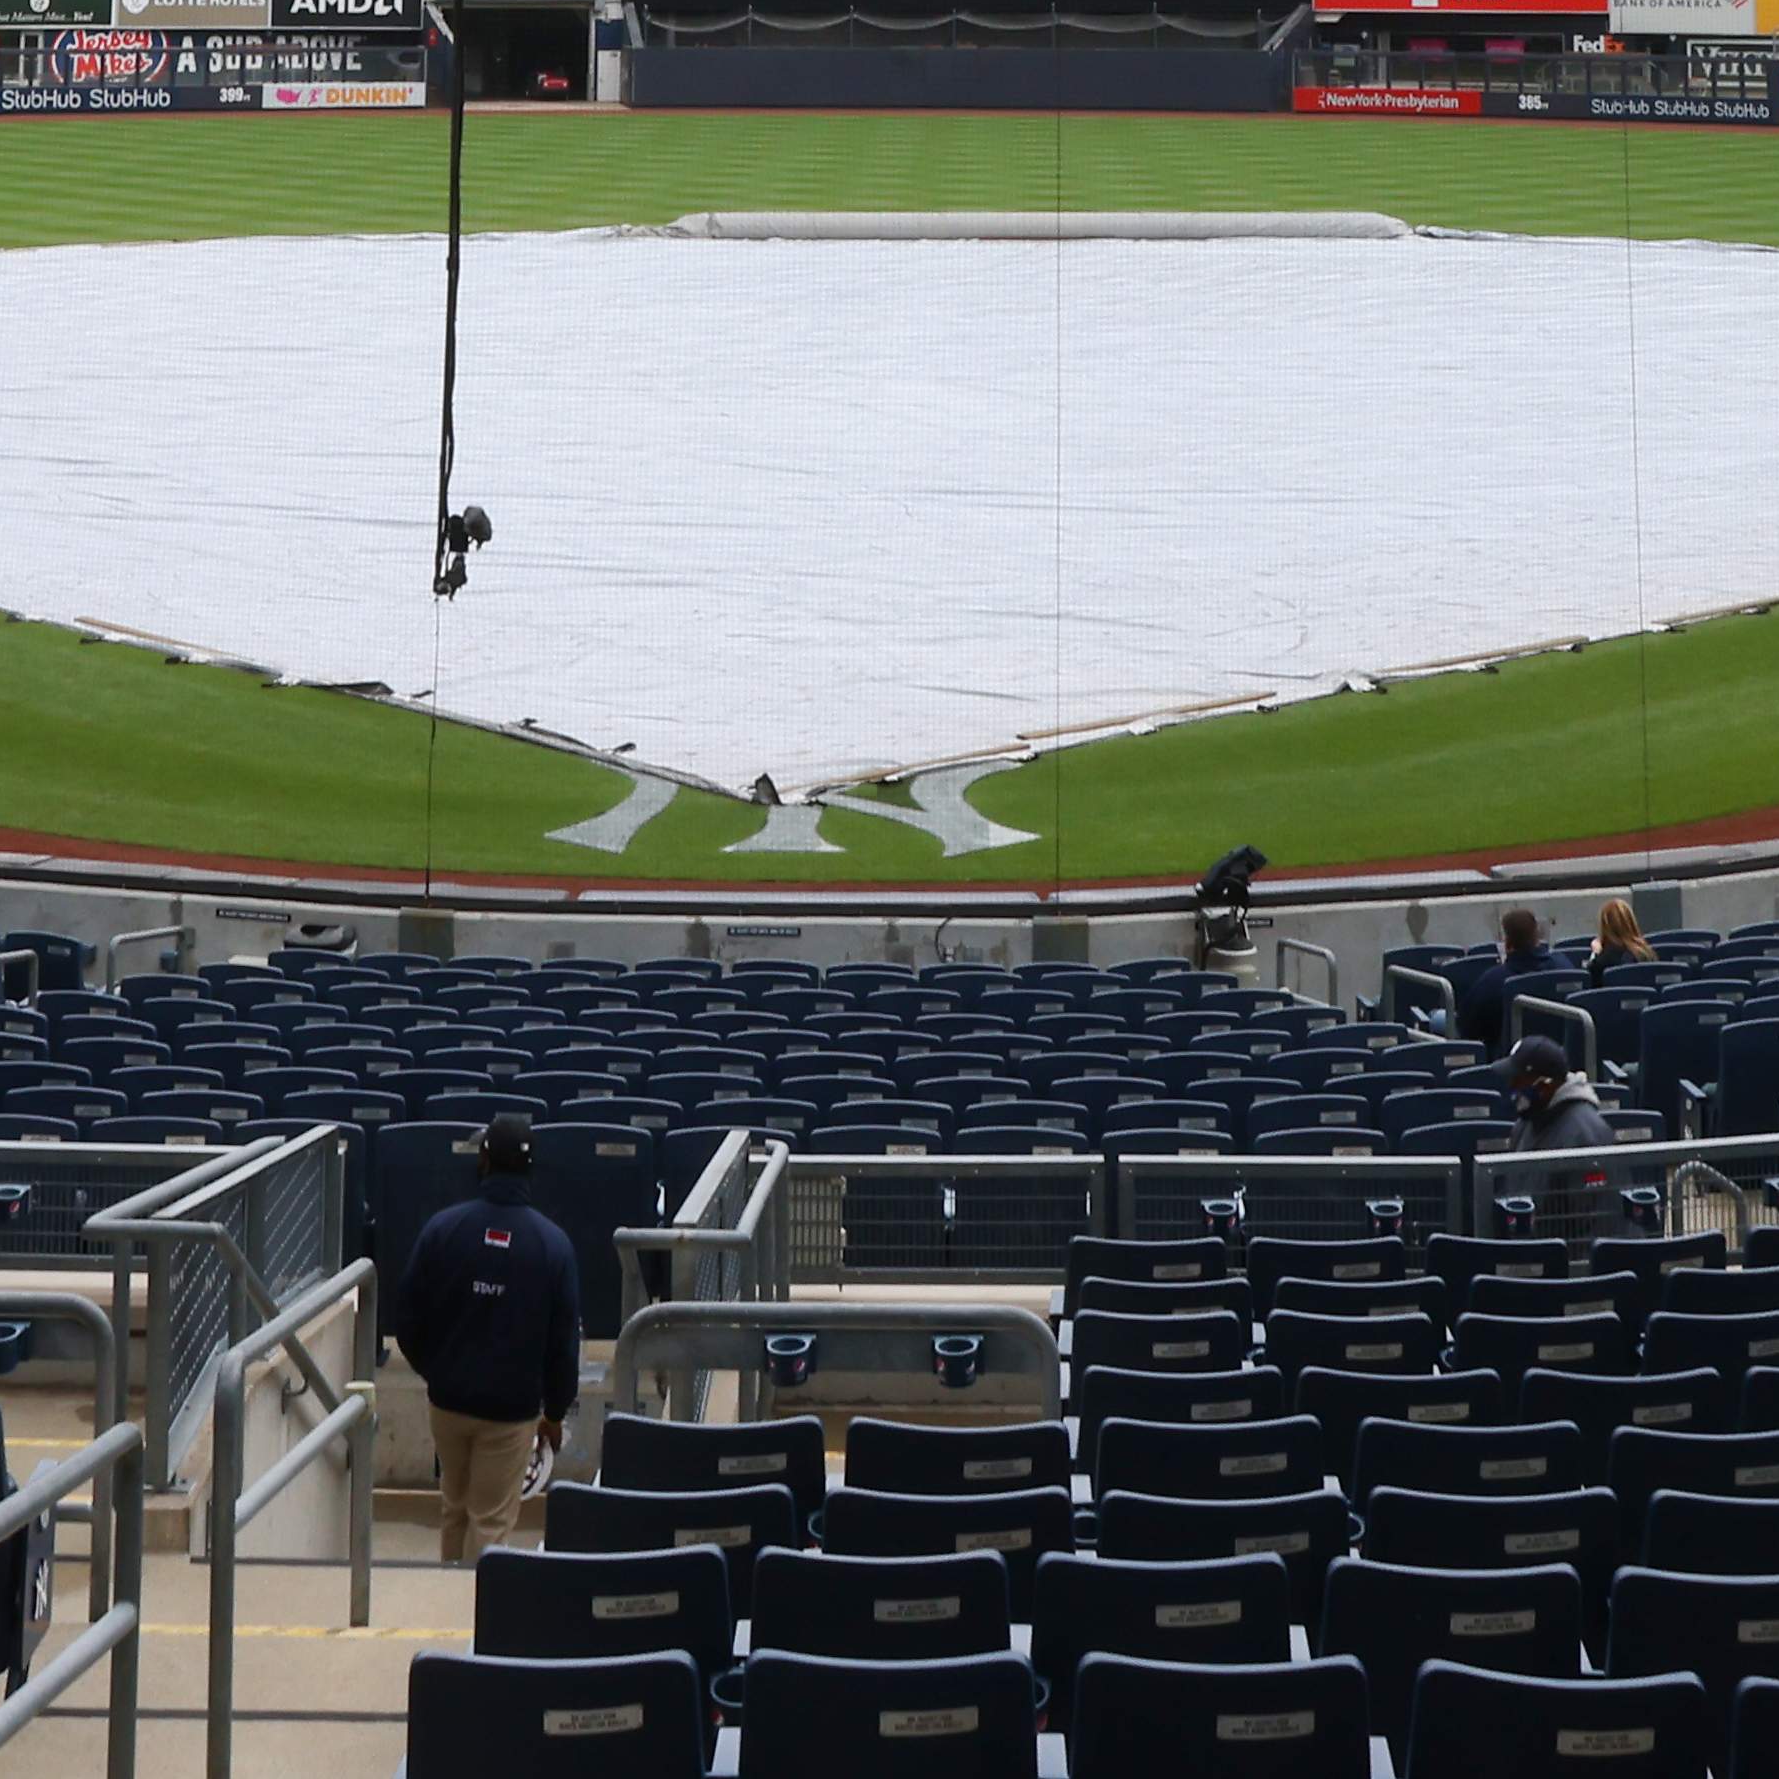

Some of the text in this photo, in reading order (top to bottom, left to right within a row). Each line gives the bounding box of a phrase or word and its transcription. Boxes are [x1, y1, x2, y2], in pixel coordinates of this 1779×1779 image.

[66, 30, 153, 52] Jersey
[1572, 34, 1626, 54] FedEx
[177, 34, 197, 73] A
[1, 89, 82, 112] StubHub
[89, 87, 172, 111] StubHub
[325, 86, 413, 104] DUNKIN'
[1591, 98, 1770, 119] StubHub StubHub StubHub
